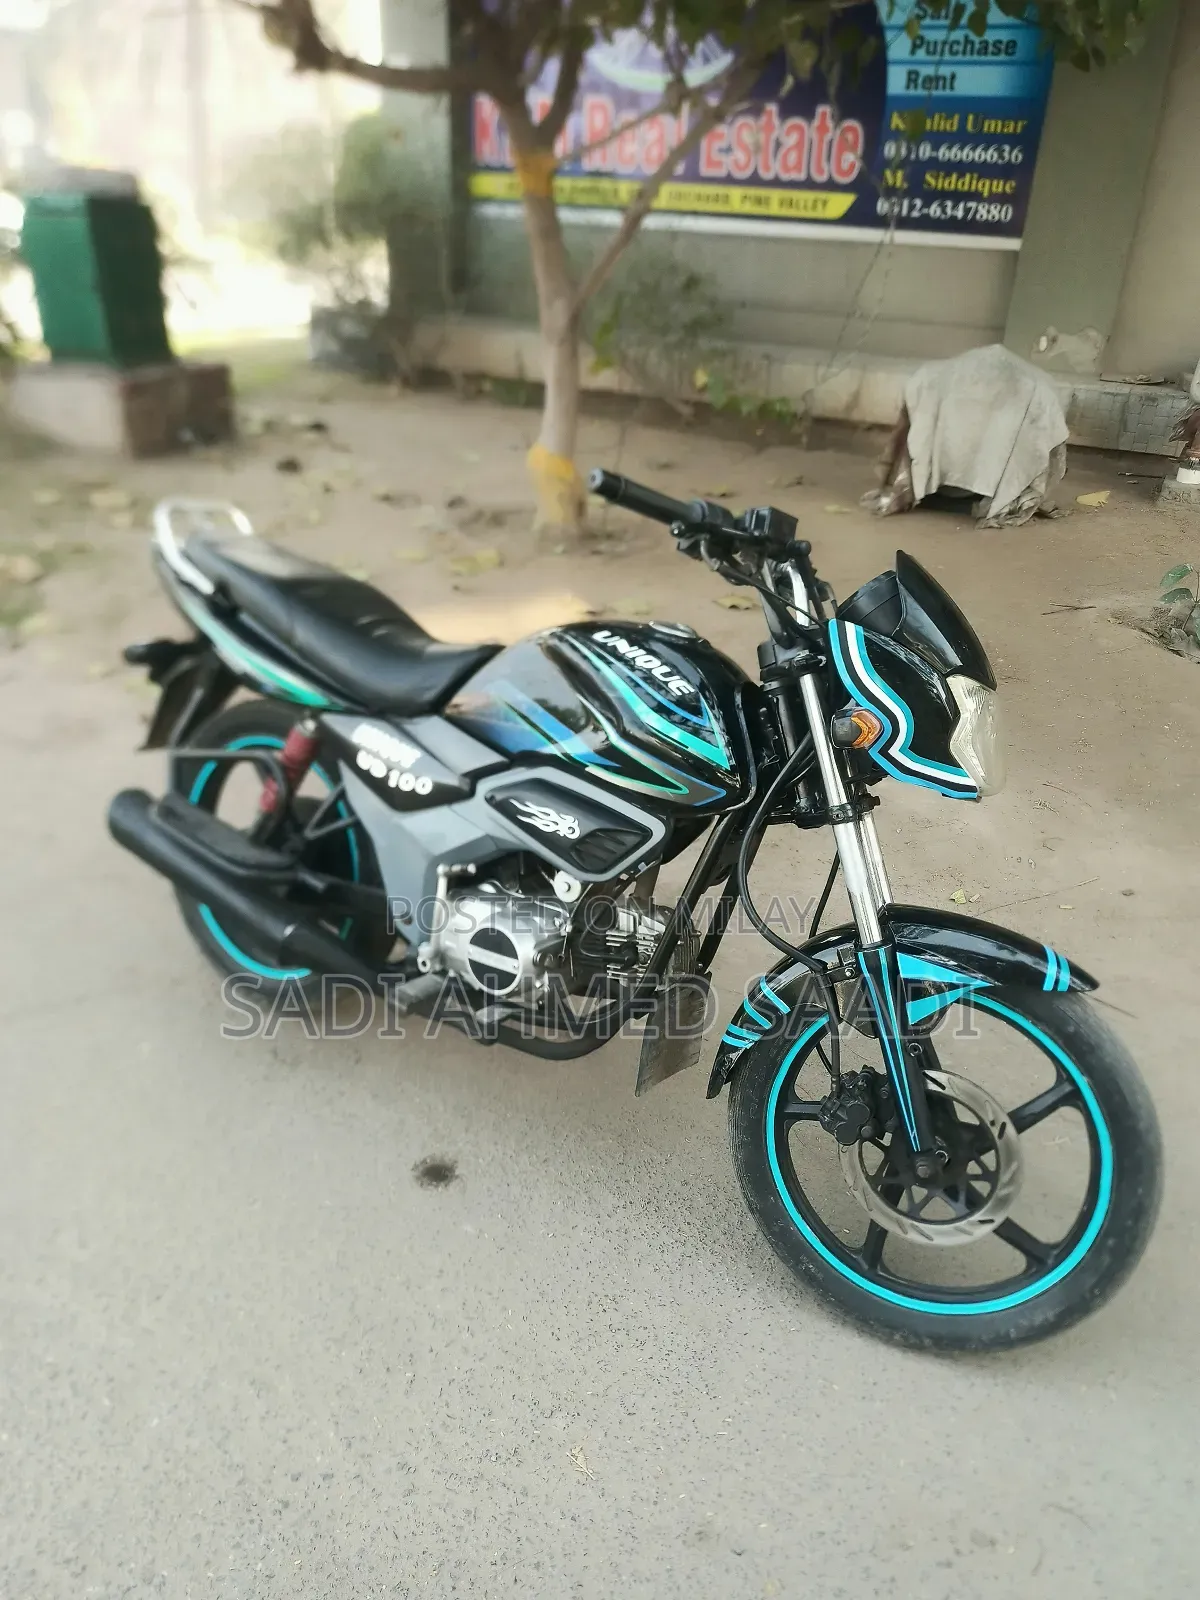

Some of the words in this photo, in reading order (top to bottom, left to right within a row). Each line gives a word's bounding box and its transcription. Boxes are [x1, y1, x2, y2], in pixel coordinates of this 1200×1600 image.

[909, 34, 1018, 57] Purchase
[905, 69, 957, 91] Rent
[890, 112, 960, 133] Klid
[966, 113, 1027, 134] Umar
[700, 103, 864, 184] Estate
[923, 170, 1016, 198] Siddique
[591, 629, 695, 698] UNIQUE
[387, 769, 433, 796] 100
